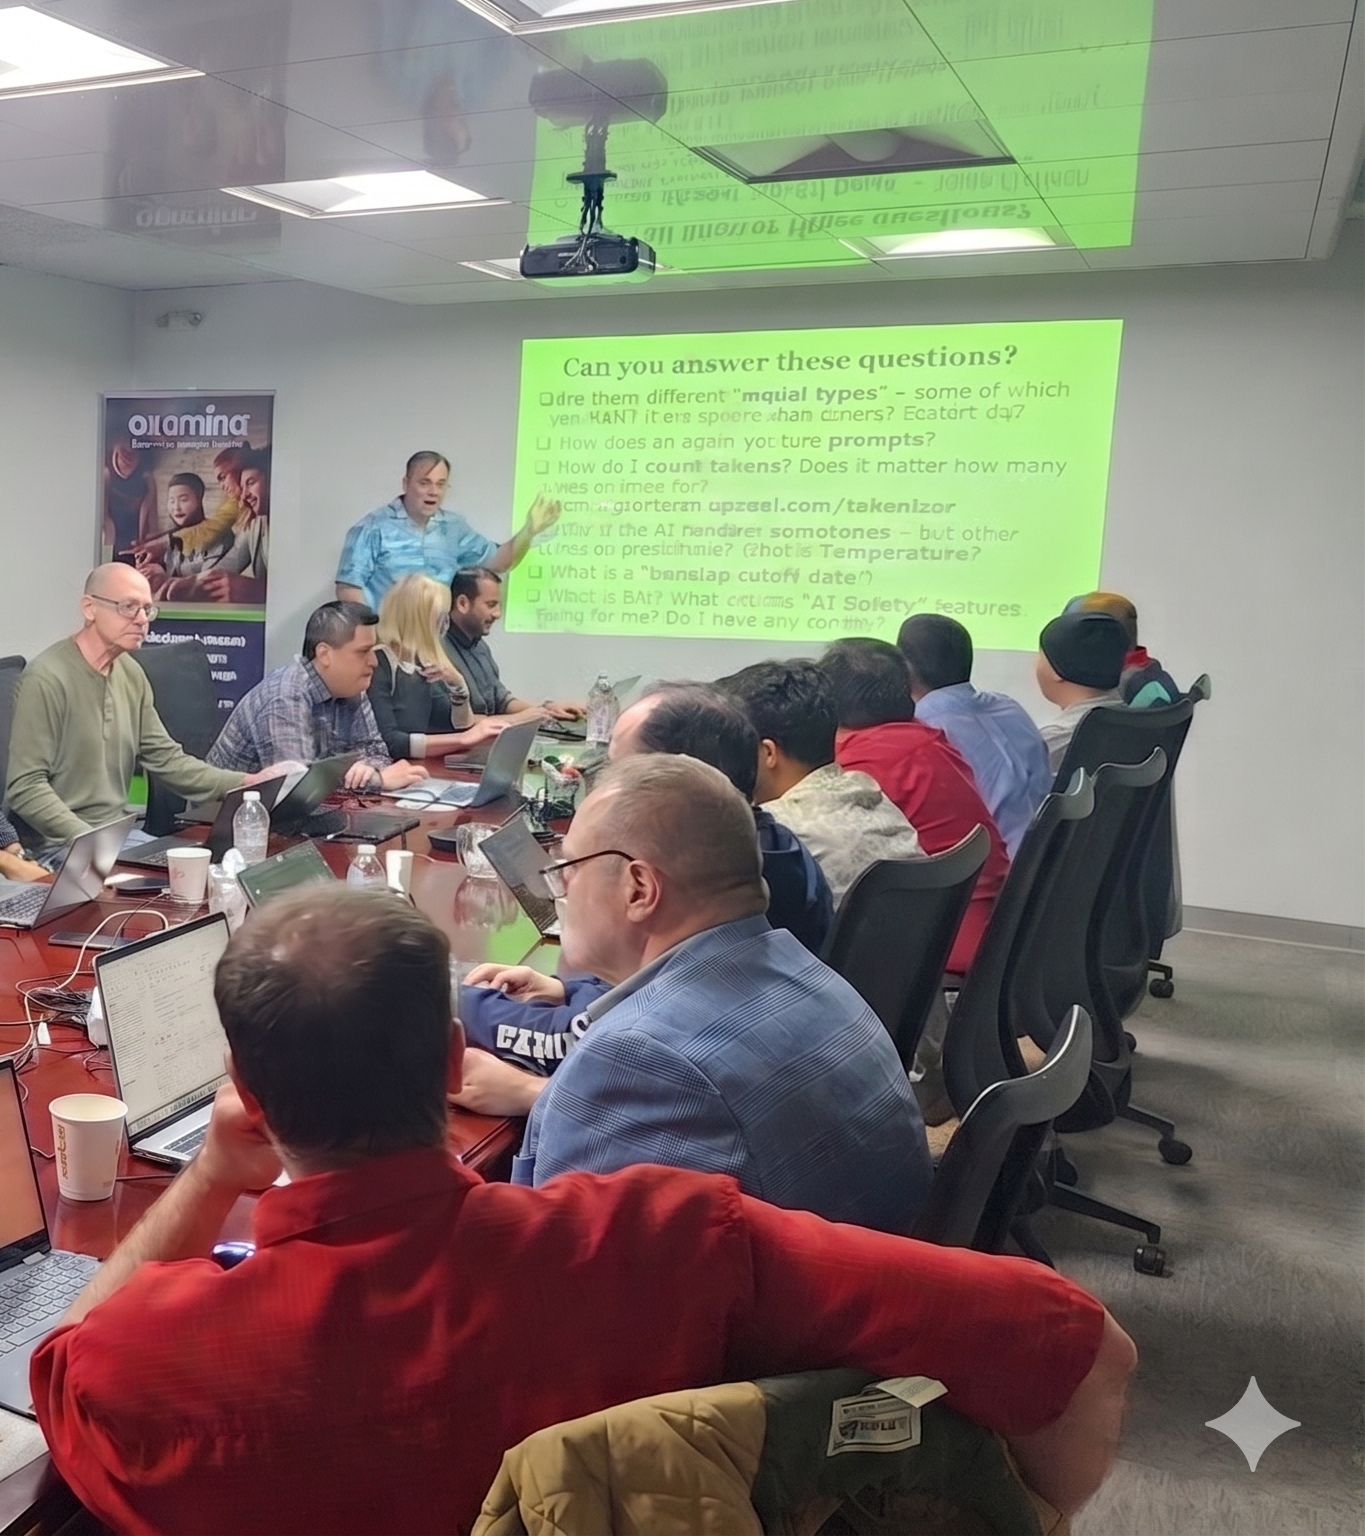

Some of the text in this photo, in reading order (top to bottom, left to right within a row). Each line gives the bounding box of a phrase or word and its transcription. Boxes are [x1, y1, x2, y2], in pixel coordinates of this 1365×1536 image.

[562, 344, 1019, 381] Can you answer these questions?
[591, 390, 640, 406] them
[646, 388, 726, 405] different
[913, 385, 972, 401] some
[978, 382, 1002, 400] of
[1007, 380, 1071, 398] which
[559, 436, 598, 450] How
[604, 435, 647, 450] does
[652, 437, 675, 450] an
[681, 433, 735, 453] again
[827, 431, 937, 453] prompts?
[557, 459, 596, 474] How
[601, 459, 624, 474] do
[630, 459, 638, 474] I
[644, 458, 702, 474] count
[799, 458, 849, 474] Does
[855, 457, 871, 474] it
[876, 457, 948, 474] matter
[953, 457, 999, 474] how
[1005, 459, 1068, 478] many
[671, 479, 710, 494] for?
[653, 523, 675, 538] AI
[961, 525, 1020, 543] other
[820, 543, 982, 564] Temperature?
[550, 565, 597, 580] What
[603, 565, 617, 580] is
[623, 568, 634, 581] a
[603, 588, 617, 603] is
[670, 591, 719, 607] What
[621, 609, 660, 625] me?
[665, 610, 692, 626] Do
[763, 614, 800, 632] any
